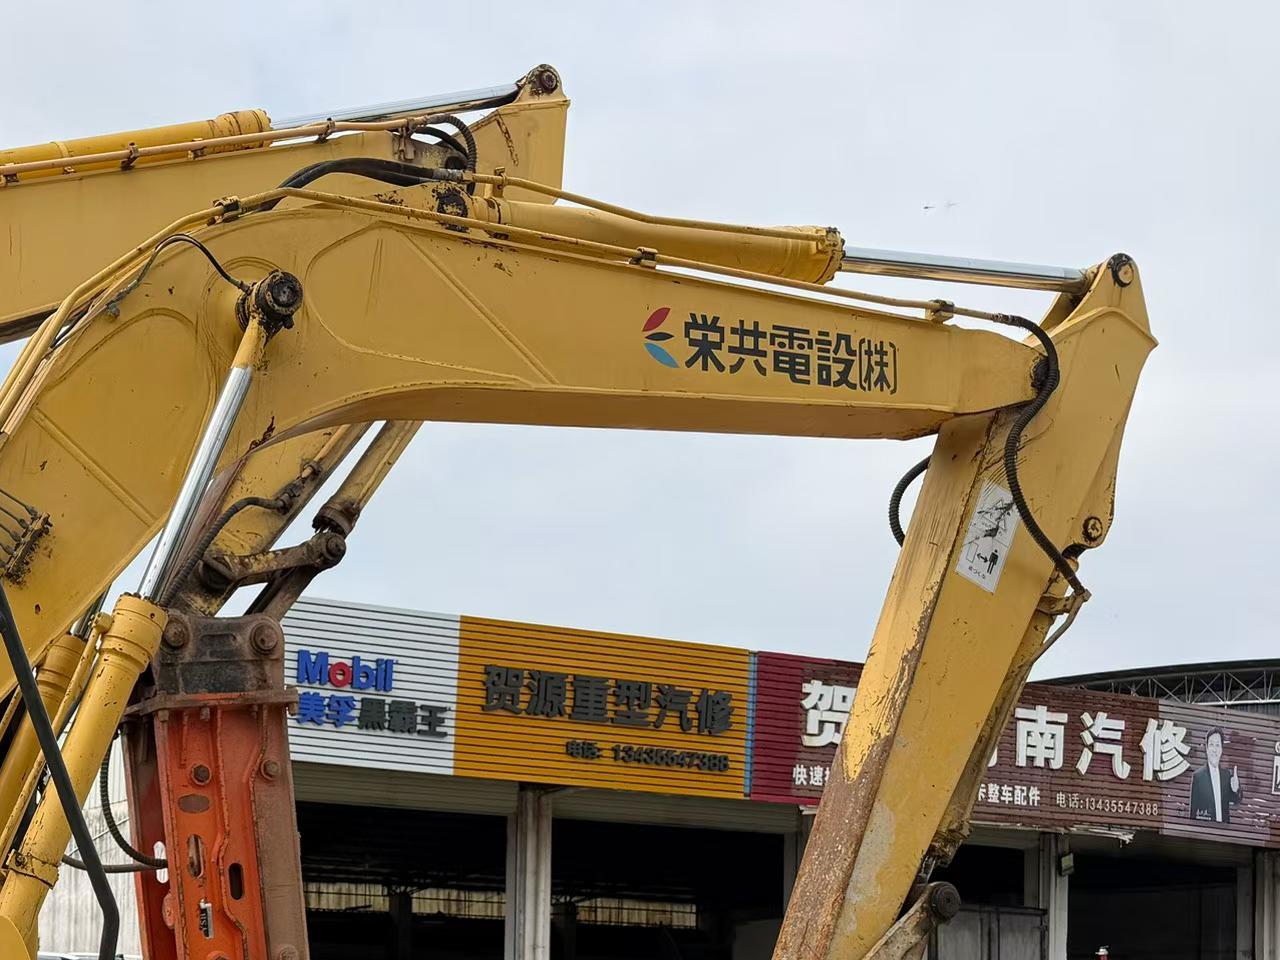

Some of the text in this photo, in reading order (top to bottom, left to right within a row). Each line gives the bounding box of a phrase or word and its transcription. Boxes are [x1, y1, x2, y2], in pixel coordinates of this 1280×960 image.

[296, 649, 394, 692] Mobil
[296, 691, 449, 738] 美孚黑霸王
[481, 664, 735, 735] 贺源重型汽修
